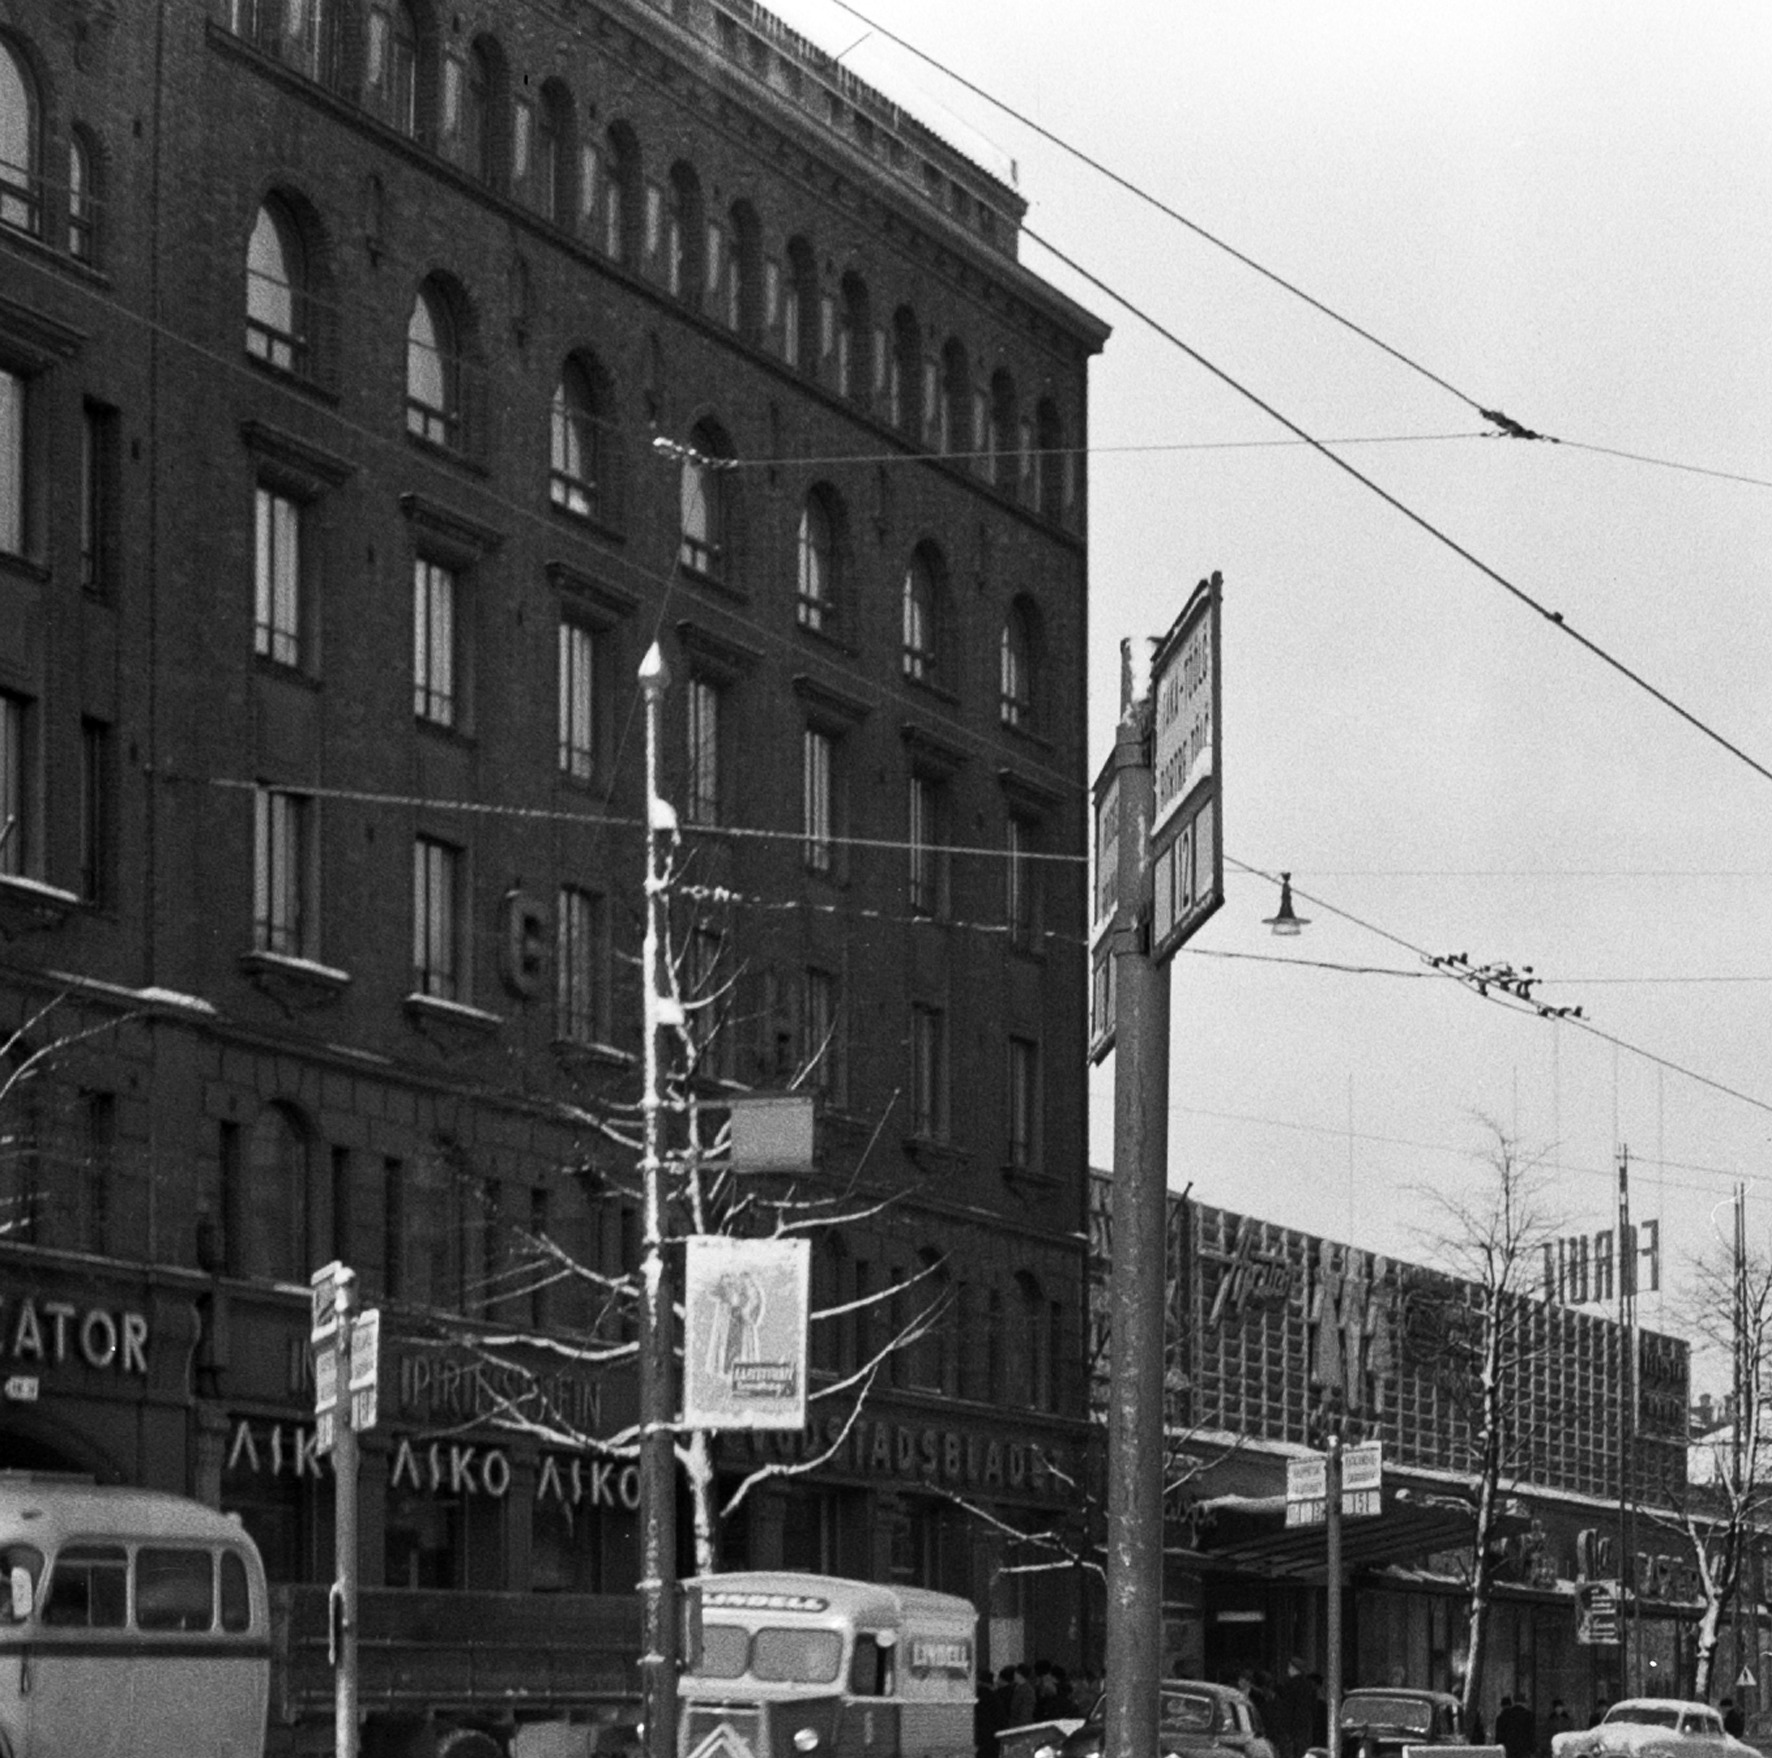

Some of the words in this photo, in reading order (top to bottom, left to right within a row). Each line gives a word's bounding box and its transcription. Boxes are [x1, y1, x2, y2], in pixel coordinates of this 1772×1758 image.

[0, 1292, 149, 1374] ATOR
[227, 1418, 326, 1481] ASK
[390, 1438, 511, 1498] ASKO
[536, 1455, 642, 1511] ASKO
